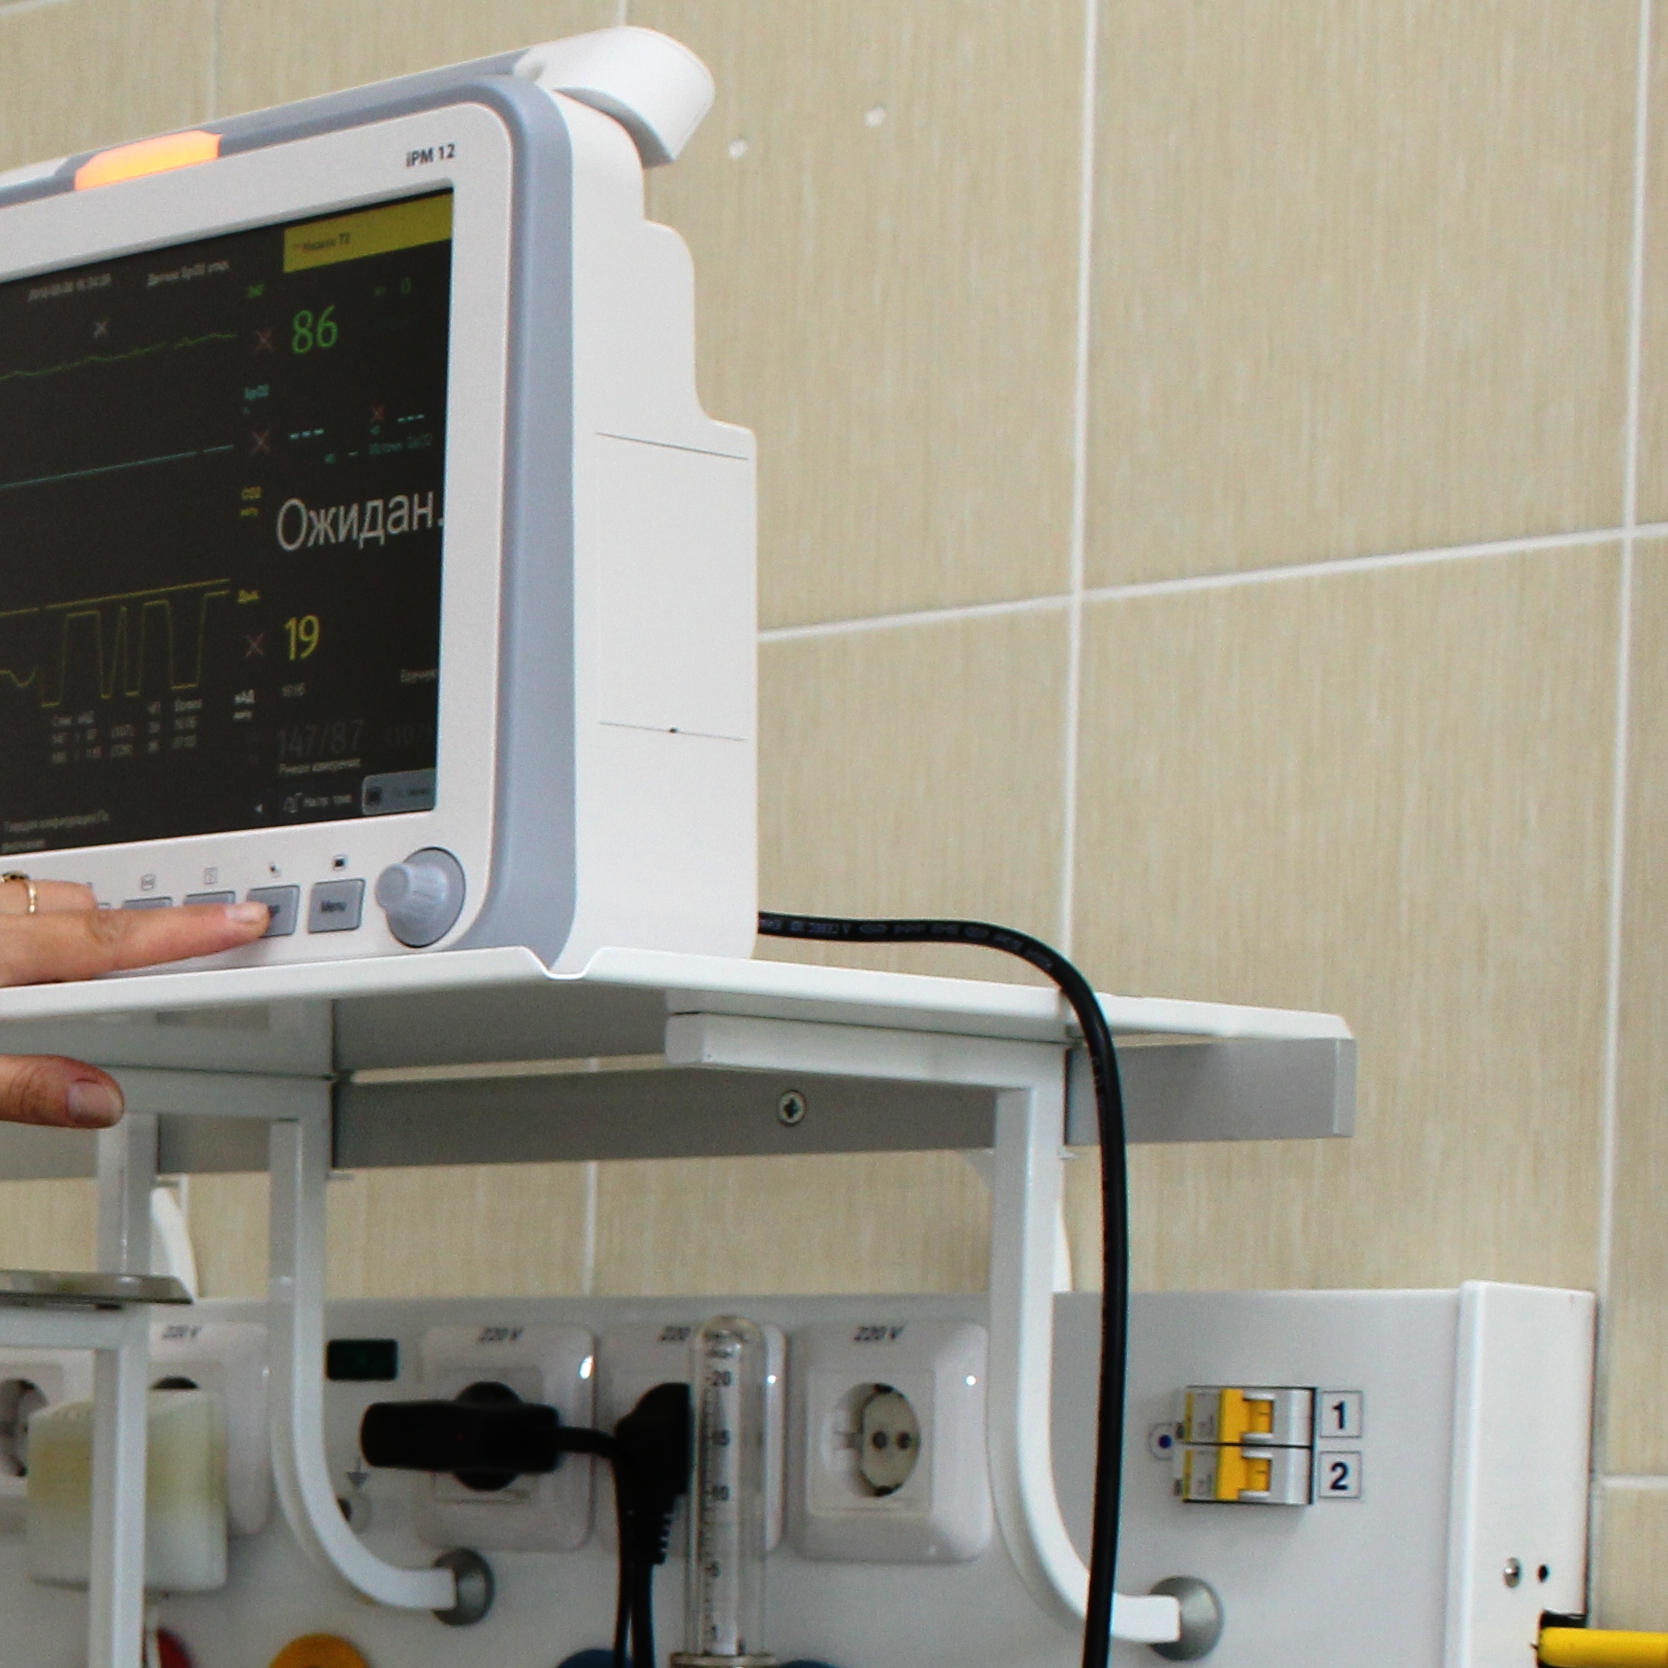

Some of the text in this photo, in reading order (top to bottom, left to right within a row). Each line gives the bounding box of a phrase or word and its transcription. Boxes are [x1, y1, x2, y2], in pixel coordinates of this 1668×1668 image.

[406, 143, 455, 168] iPM 12
[291, 304, 338, 354] 86
[276, 490, 444, 552] Ожидан.
[284, 614, 320, 662] 19
[854, 1325, 886, 1342] 220
[1333, 1401, 1345, 1430] 1
[1329, 1462, 1349, 1491] 2
